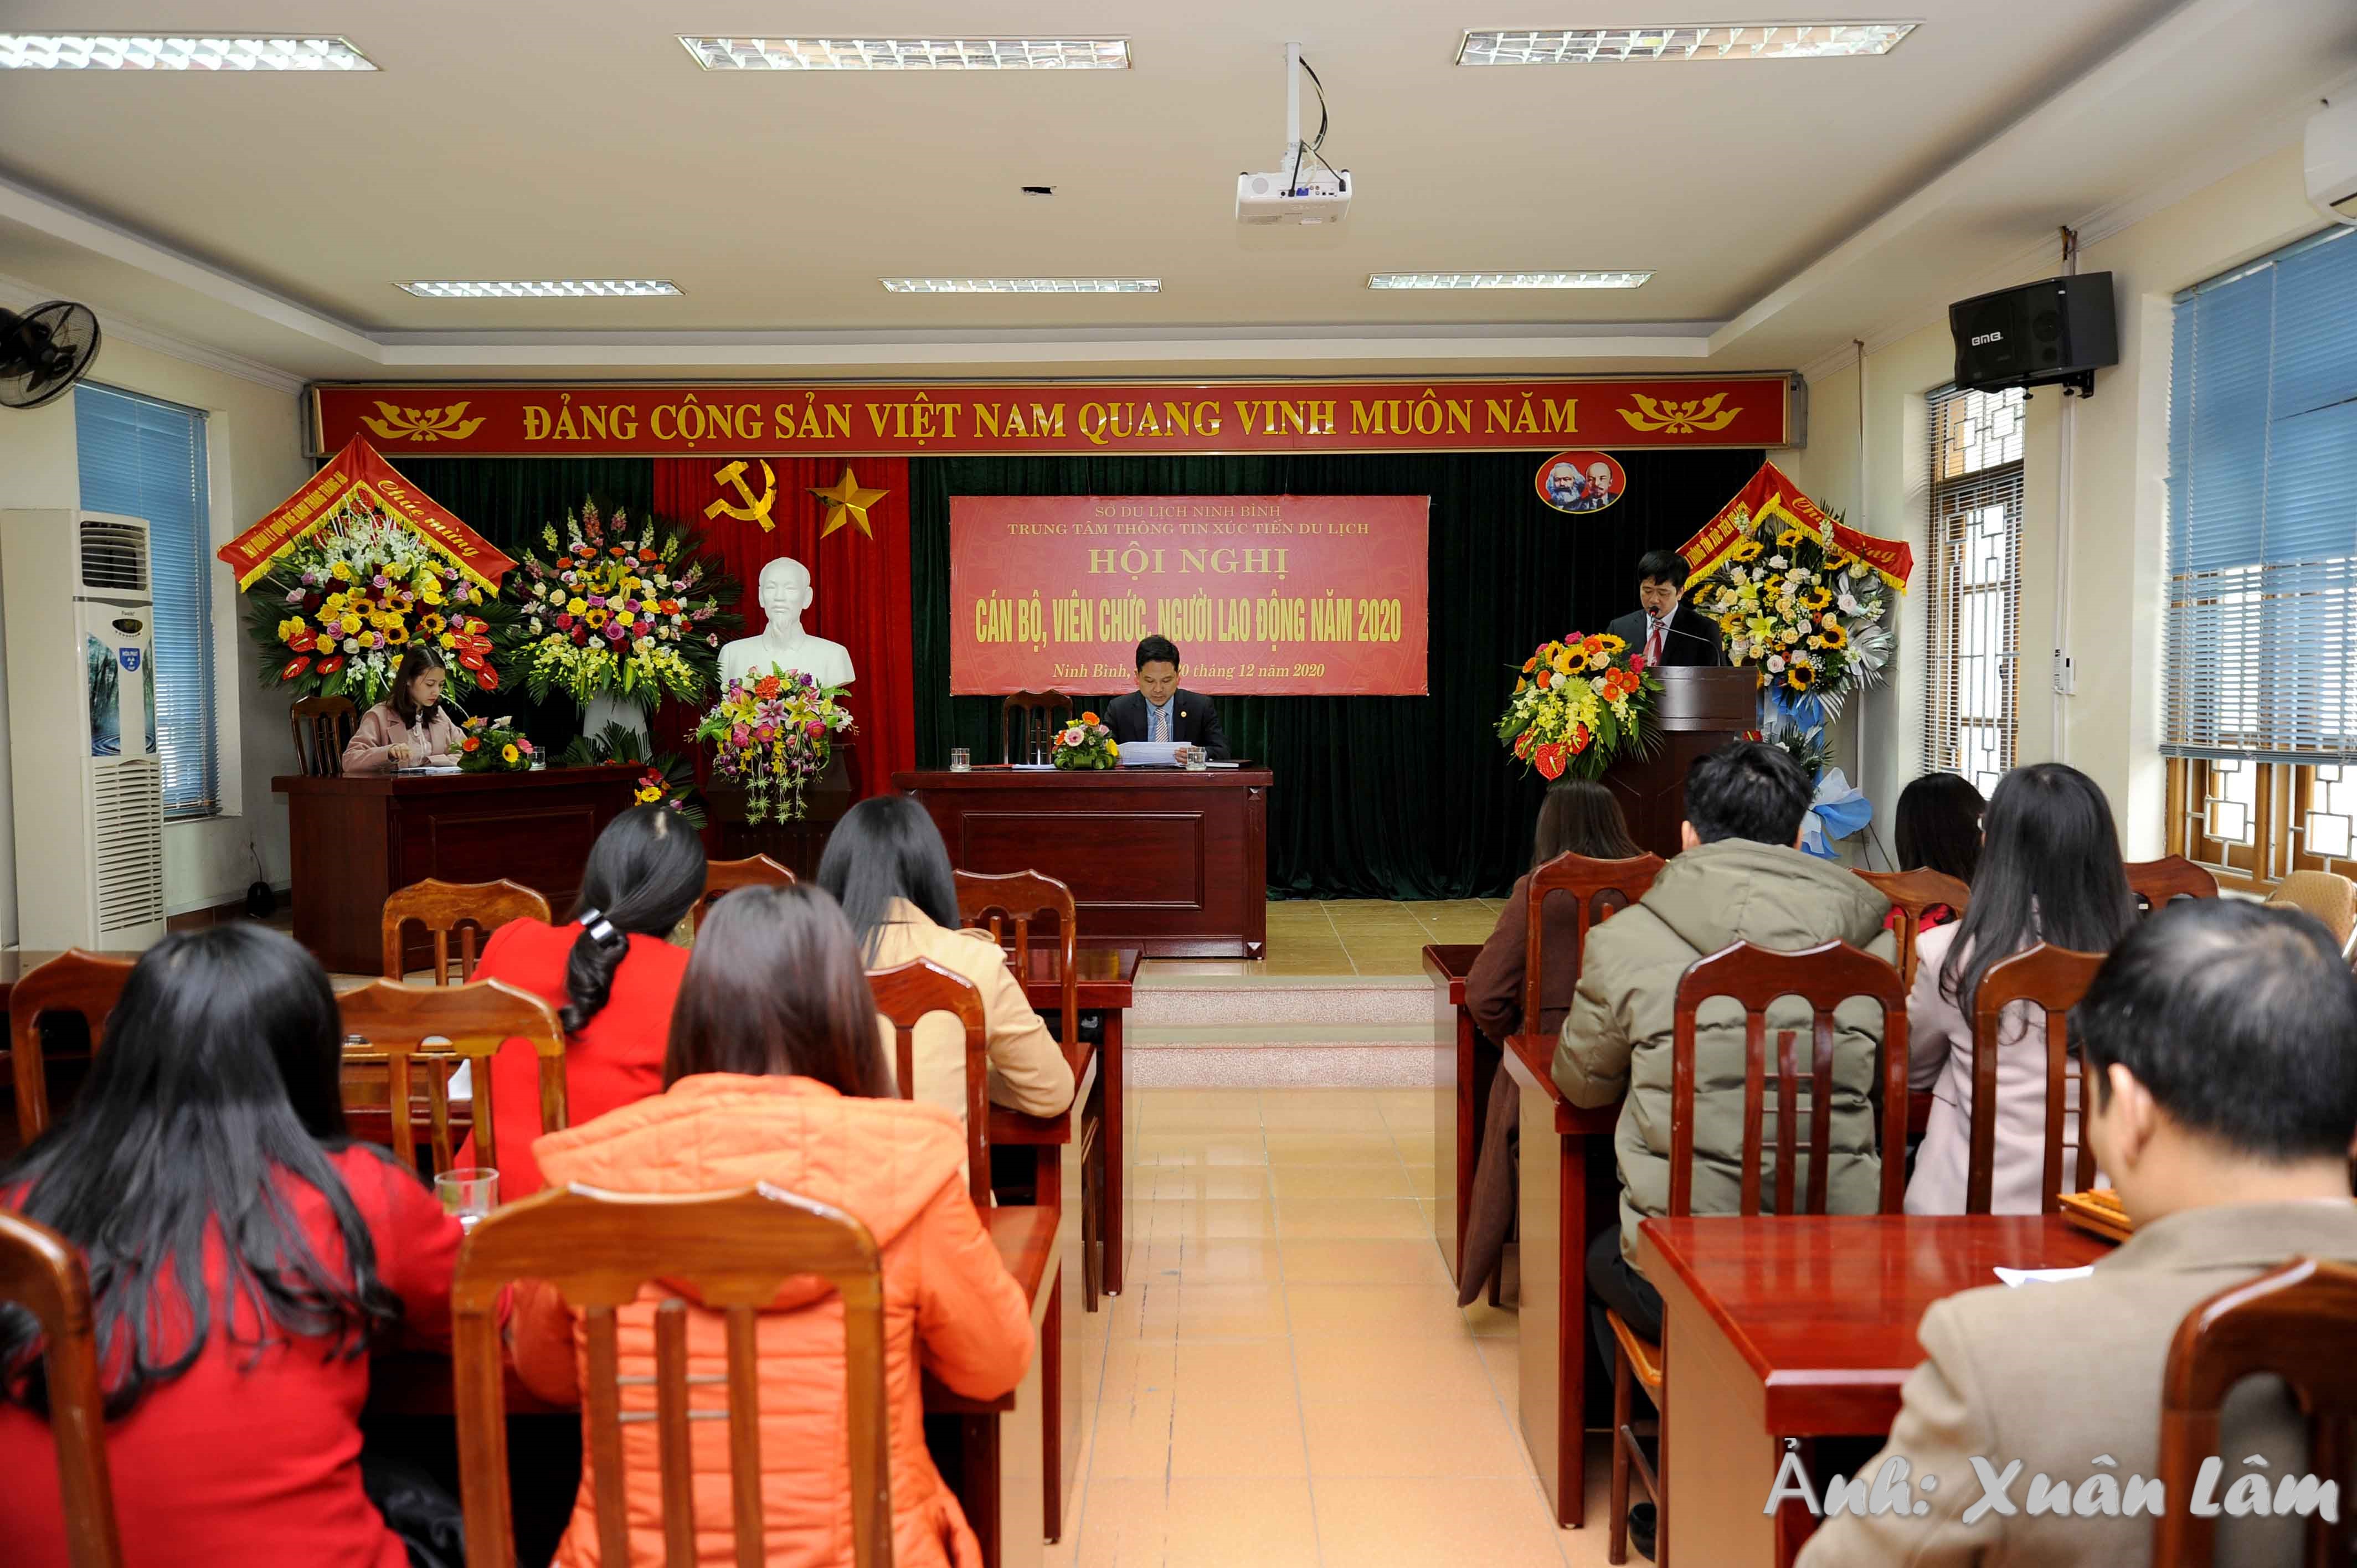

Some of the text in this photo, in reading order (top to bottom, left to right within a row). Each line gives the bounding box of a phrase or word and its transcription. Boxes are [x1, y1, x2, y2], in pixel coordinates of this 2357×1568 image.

[523, 388, 1578, 447] ĐẢNG CỘNG SẢN VIỆT NAM QUANG VINH MUÔN NĂM
[378, 480, 480, 558] Chúc mừng
[1008, 519, 1369, 536] TRUNG TÂM THÔNG TIN XÚC TIẾN DU LỊCH
[1095, 503, 1280, 519] SỞ DU LỊCH NINH BÌNH
[1088, 541, 1289, 580] HỘI NGHỊ
[976, 590, 1012, 642] CÁN
[1018, 590, 1047, 652] BỘ,
[1053, 590, 1093, 642] VIÊN
[1157, 587, 1212, 642] NGƯỜI
[1218, 598, 1250, 642] LAO
[1256, 589, 1305, 652] ĐỘNG
[1311, 589, 1352, 642] NĂM
[1358, 599, 1401, 642] 2020
[1052, 664, 1088, 678] Ninh
[1092, 664, 1130, 679] Bình,
[1193, 664, 1236, 679] tháng
[1239, 664, 1254, 677] 12
[1258, 664, 1289, 677] năm
[1293, 664, 1325, 677] 2020
